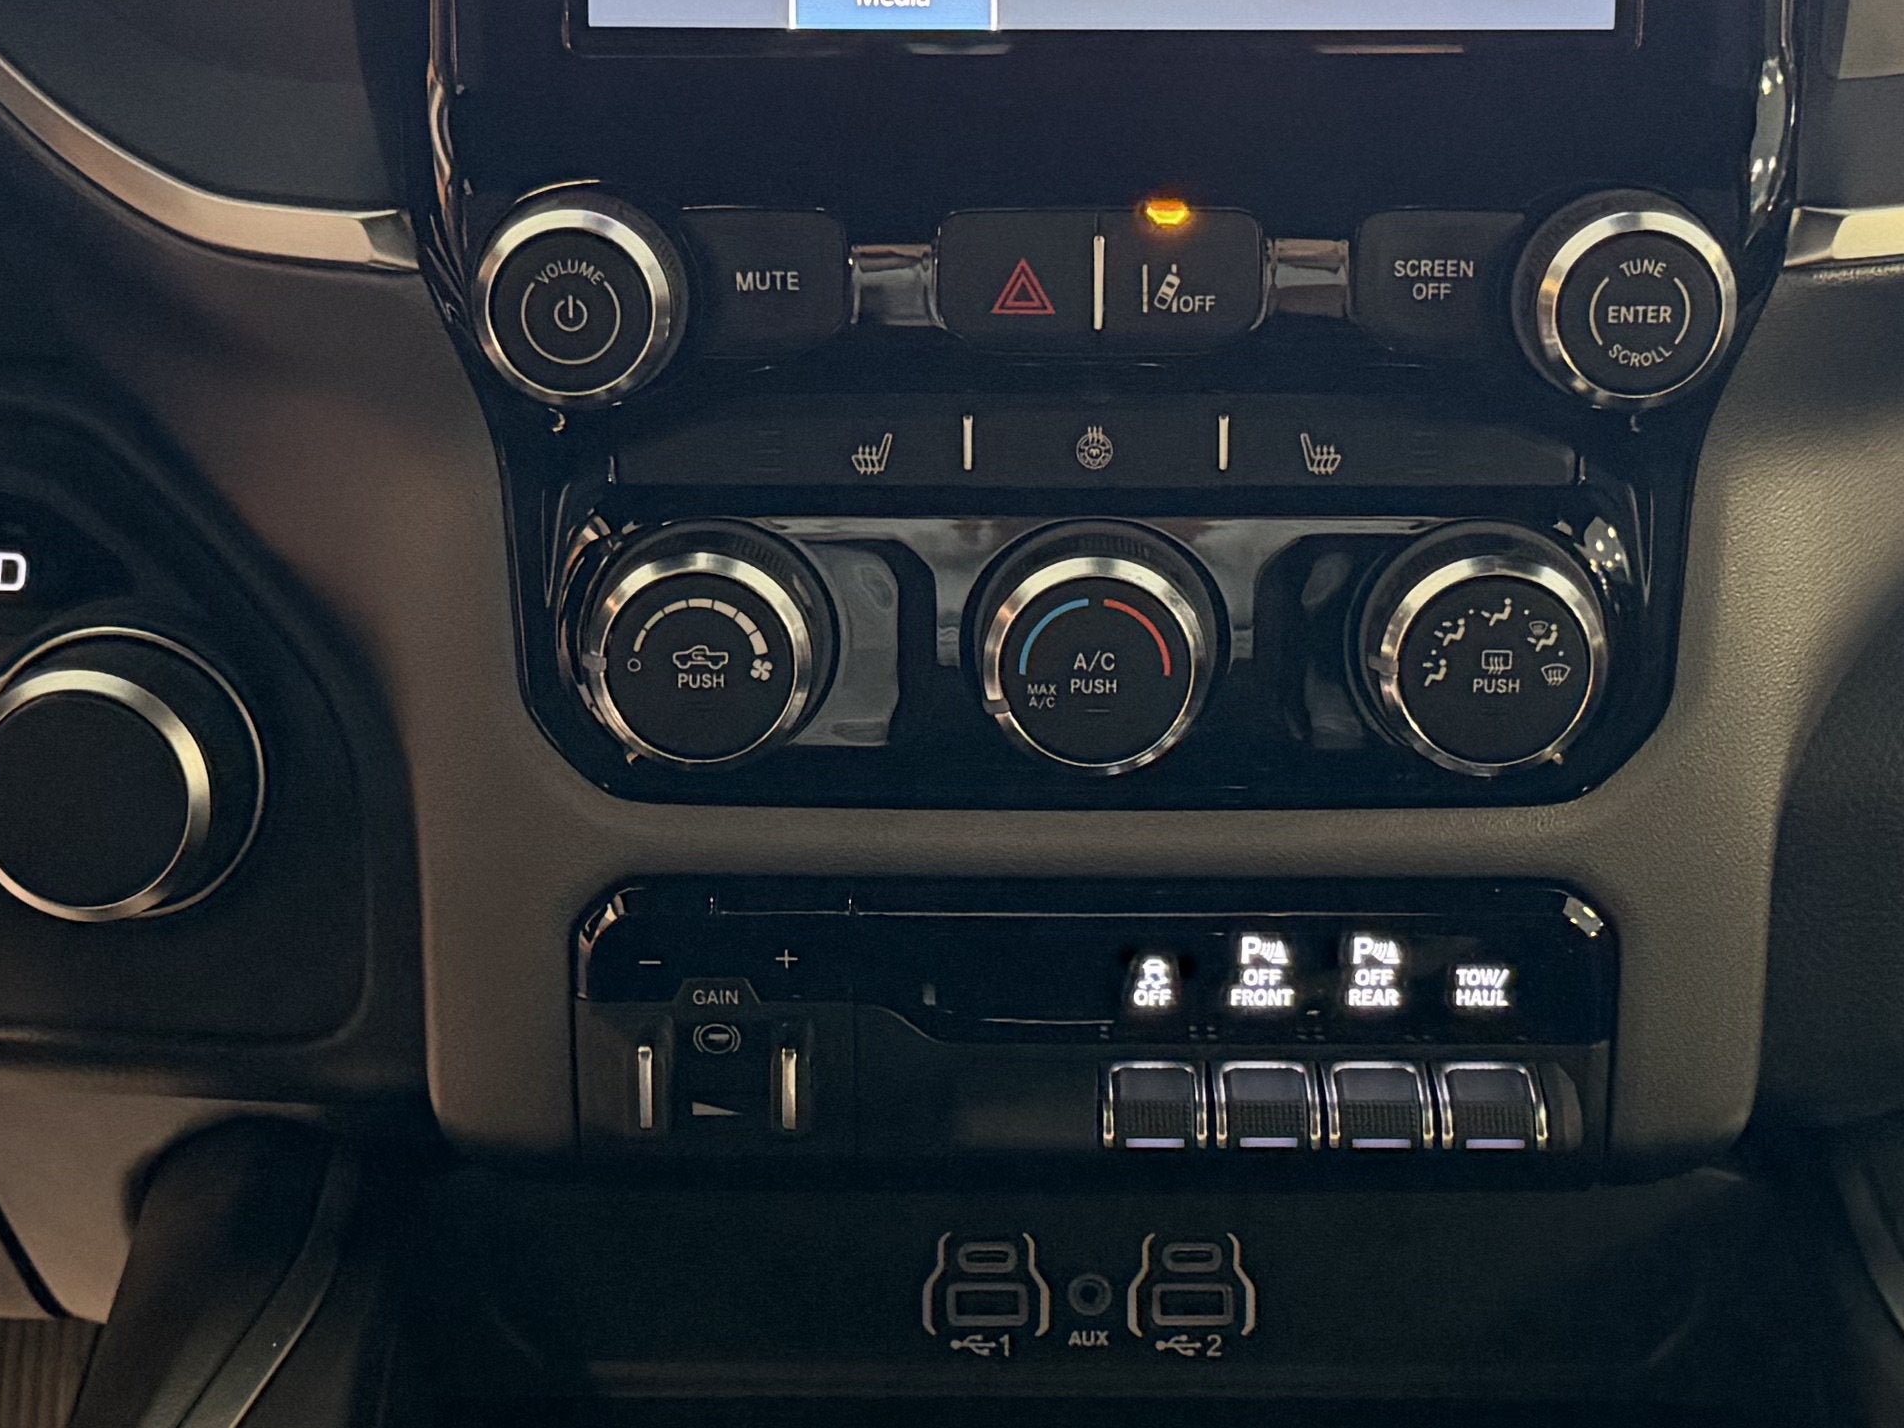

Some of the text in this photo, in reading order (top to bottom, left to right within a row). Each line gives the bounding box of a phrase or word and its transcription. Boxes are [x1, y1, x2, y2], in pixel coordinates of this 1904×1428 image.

[534, 259, 607, 287] VOLUME
[1394, 259, 1474, 279] SCREEN
[1619, 258, 1668, 279] TUNE
[735, 271, 799, 292] MUTE
[1412, 283, 1452, 302] OFF
[1179, 295, 1216, 314] OFF
[1608, 305, 1672, 325] ENTER
[1607, 344, 1672, 368] SCROLL
[1074, 651, 1116, 673] A/C
[678, 673, 725, 690] PUSH
[1027, 683, 1058, 696] MAX
[1071, 679, 1118, 694] PUSH
[1473, 679, 1520, 694] PUSH
[1028, 696, 1057, 709] A/C
[1244, 969, 1280, 985] OFF
[1355, 969, 1394, 986] OFF
[1456, 969, 1508, 987] TOW/
[692, 990, 740, 1005] GAIN
[1134, 989, 1171, 1006] OFF
[1231, 988, 1294, 1006] FRONT
[1348, 988, 1399, 1006] REAR
[1456, 989, 1509, 1007] HAUL
[1001, 1336, 1010, 1357] 1
[1068, 1331, 1108, 1347] AUX
[1206, 1335, 1222, 1357] 2
